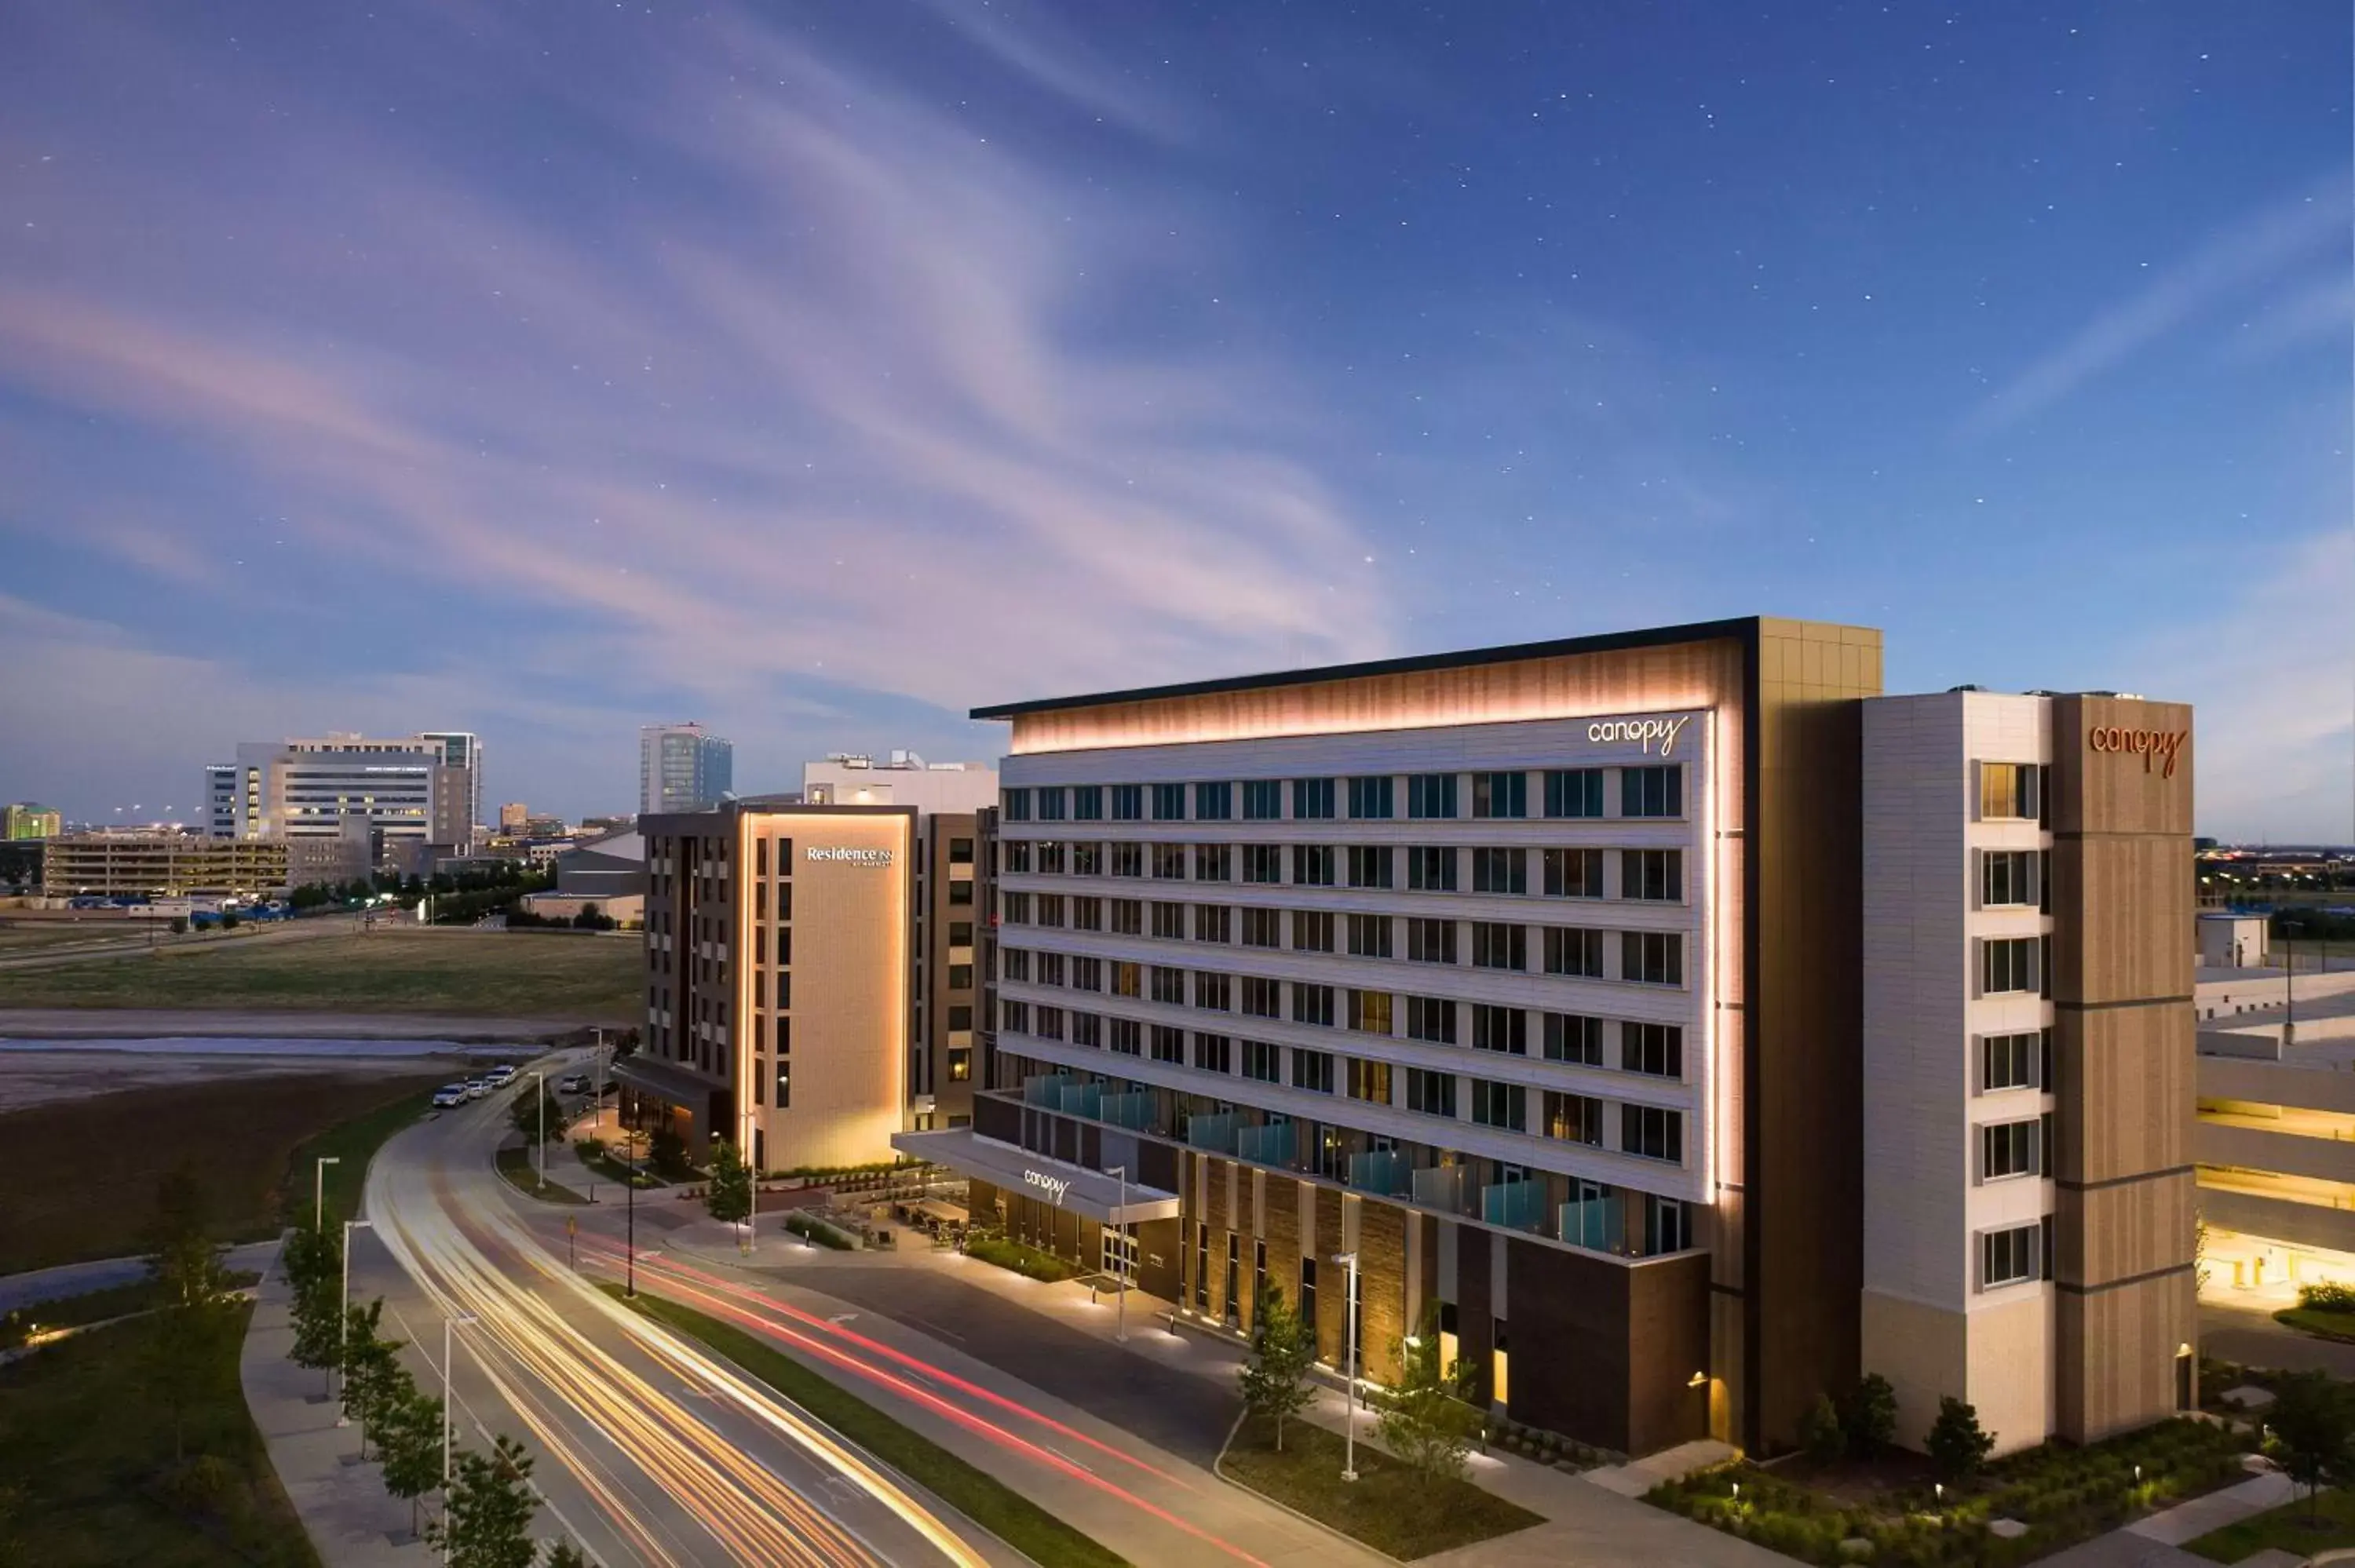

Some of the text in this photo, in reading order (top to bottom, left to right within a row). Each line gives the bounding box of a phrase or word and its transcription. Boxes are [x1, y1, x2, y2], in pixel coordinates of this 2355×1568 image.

[1588, 716, 1689, 757] canopy
[2090, 727, 2188, 779] canopy
[807, 847, 877, 861] Residence
[1024, 1169, 1071, 1206] canopy
